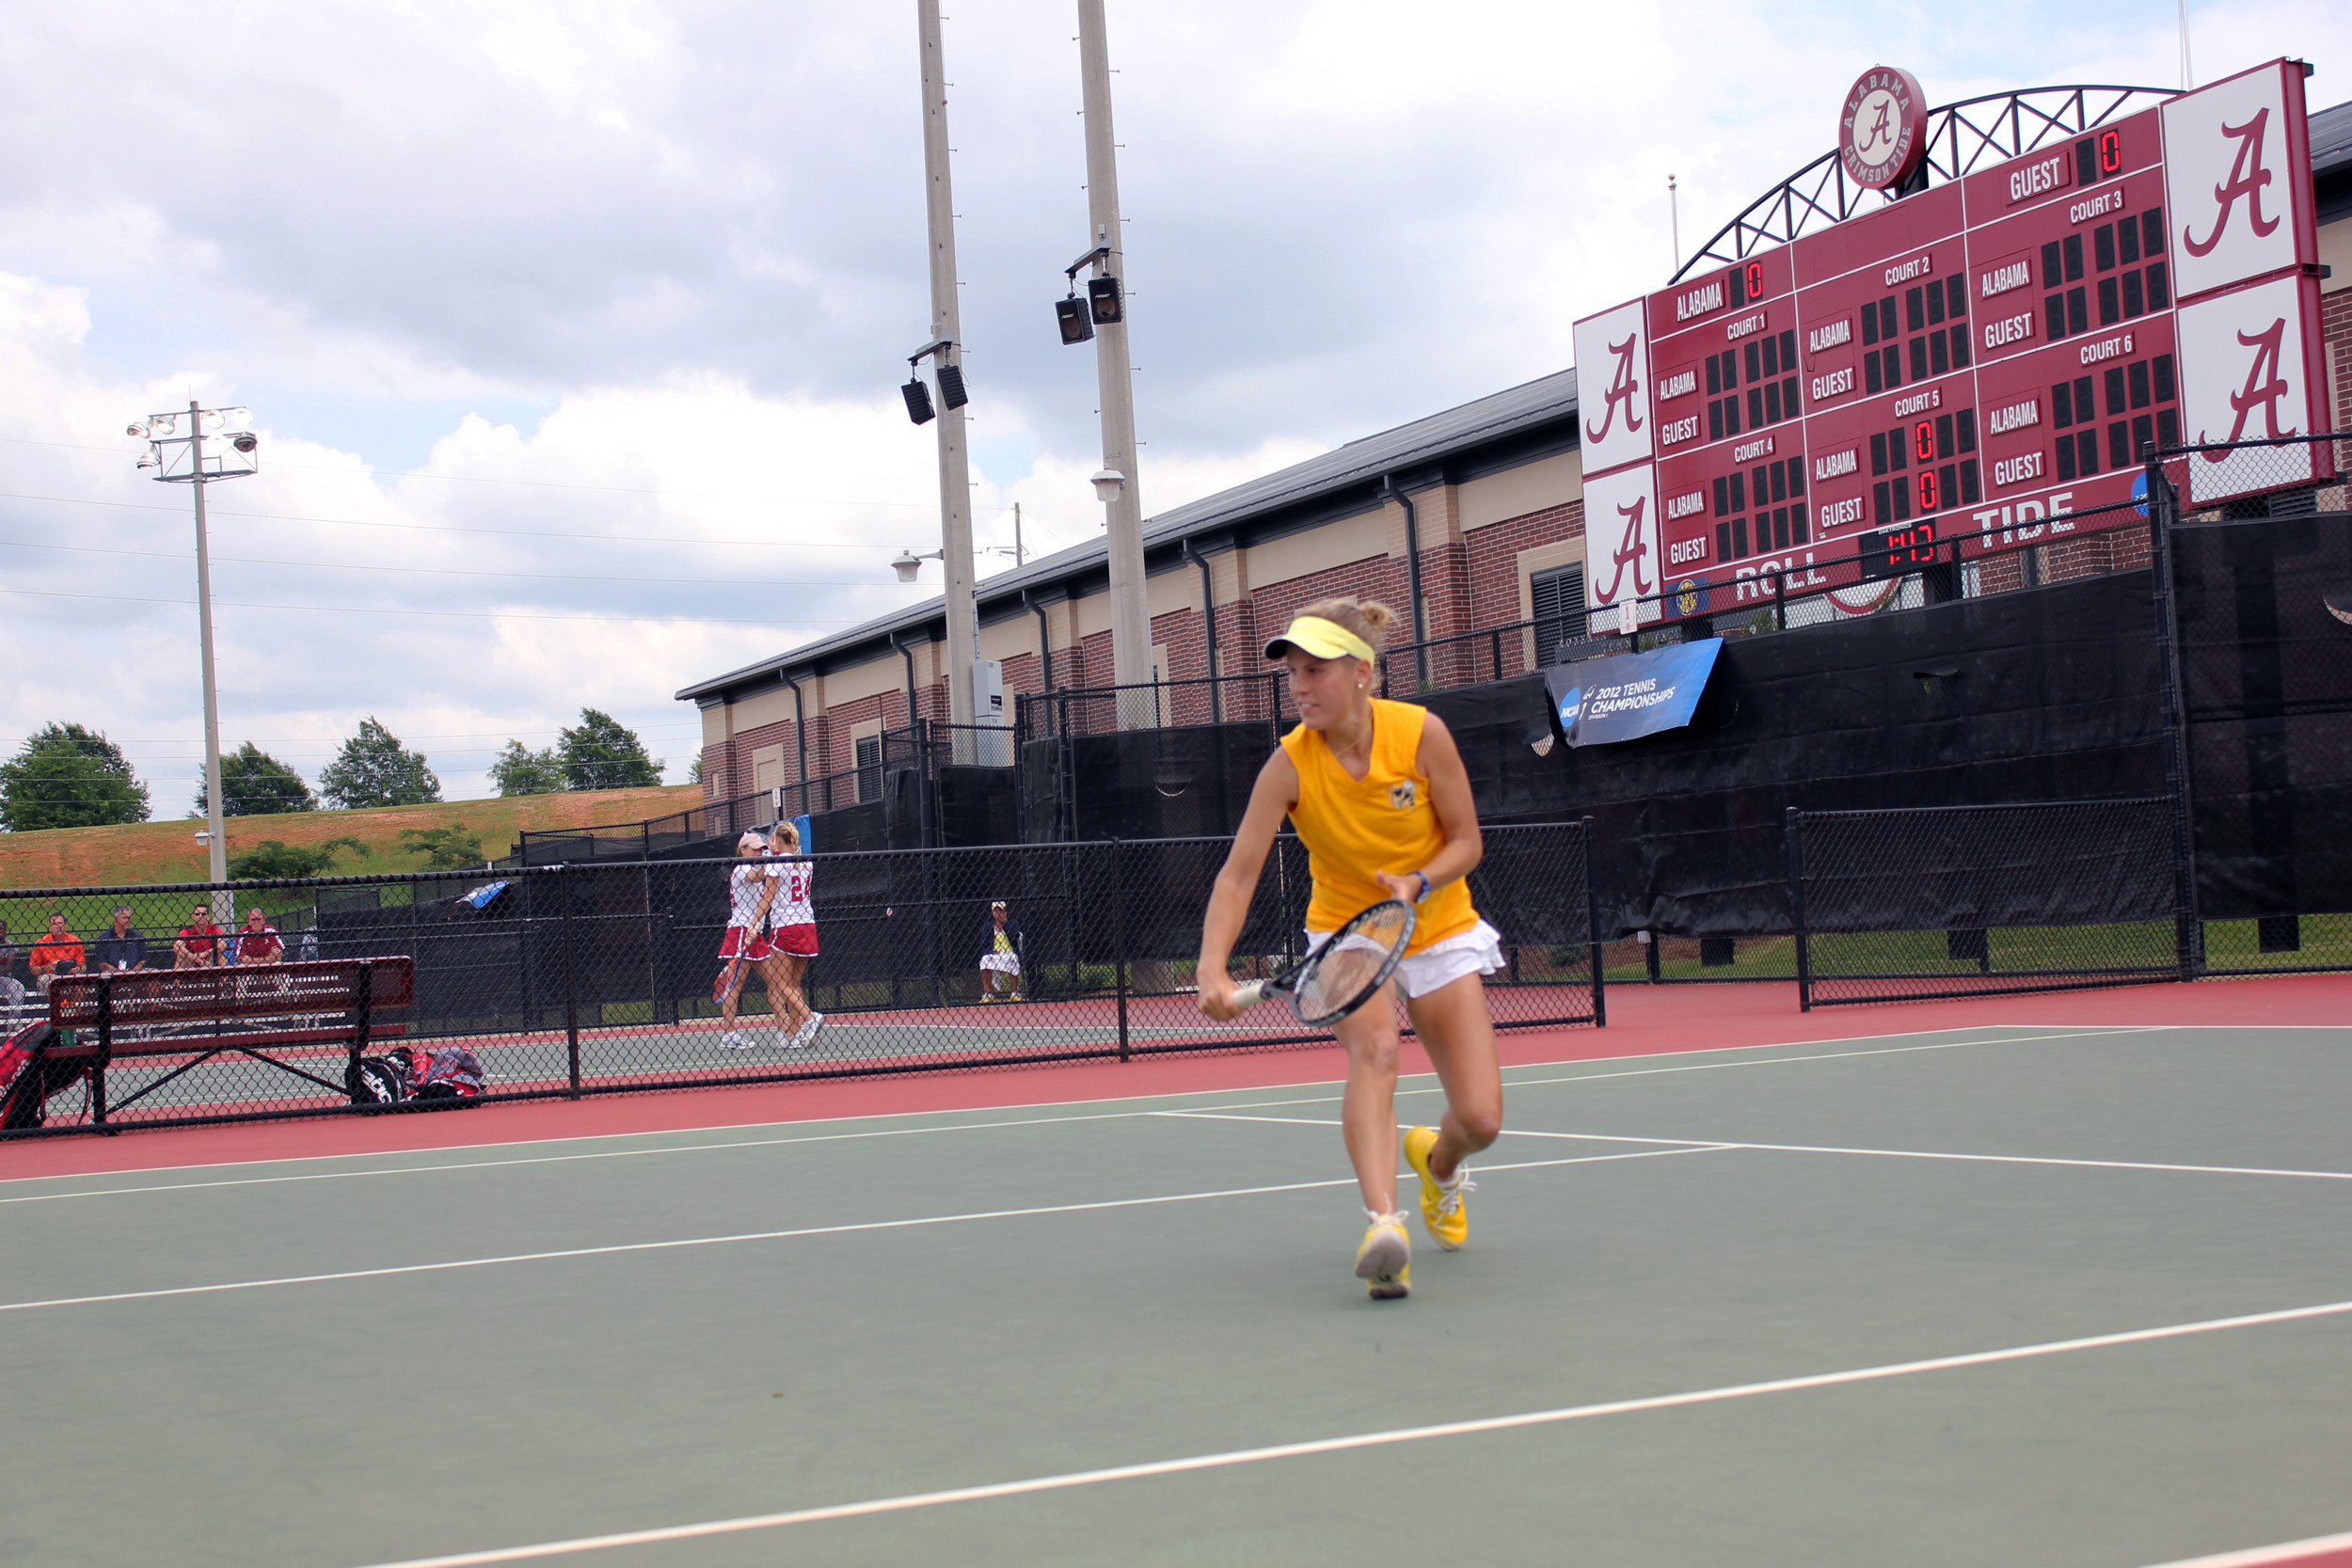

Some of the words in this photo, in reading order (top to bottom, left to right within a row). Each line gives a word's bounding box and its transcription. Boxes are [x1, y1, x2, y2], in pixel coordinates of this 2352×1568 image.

[1843, 73, 1910, 129] ALABAMA
[1859, 99, 1892, 152] A
[1844, 145, 1890, 182] CRIMSON
[1889, 127, 1911, 167] TIDE
[2101, 131, 2122, 172] 0
[2010, 157, 2060, 200] GUEST
[2183, 107, 2280, 258] A
[2070, 194, 2111, 224] COURT
[2113, 190, 2122, 209] 3
[1748, 262, 1763, 298] 0
[1884, 259, 1920, 286] COURT
[1922, 257, 1930, 273] 2
[1981, 261, 2030, 297] ALABAMA
[1677, 282, 1723, 323] ALABAMA
[1727, 315, 1758, 341] COURT
[1758, 313, 1766, 329] 1
[1809, 319, 1851, 353] ALABAMA
[1984, 312, 2032, 349] GUEST
[2080, 337, 2122, 365] COURT
[2123, 335, 2133, 353] 6
[1586, 333, 1644, 444] A
[1660, 370, 1696, 402] ALABAMA
[1812, 368, 1853, 401] GUEST
[2198, 317, 2296, 464] A
[1895, 392, 1931, 418] COURT
[1931, 390, 1940, 406] 5
[1990, 400, 2039, 435] ALABAMA
[1661, 416, 1699, 447] GUEST
[1915, 421, 1933, 459] 0
[1734, 440, 1767, 464] COURT
[1767, 437, 1774, 453] 4
[1816, 449, 1857, 481] ALABAMA
[1994, 451, 2042, 486] GUEST
[1667, 491, 1704, 520] ALABAMA
[1920, 471, 1936, 509] 0
[1821, 497, 1862, 529] GUEST
[1595, 495, 1652, 605] A
[1670, 536, 1708, 564] GUEST
[1736, 552, 1827, 601] ROLL
[1973, 492, 2075, 548] TIDE
[1591, 686, 1677, 715] CHAMPIONSHIPS
[1596, 686, 1622, 700] 2012
[1623, 677, 1657, 695] TENNIS
